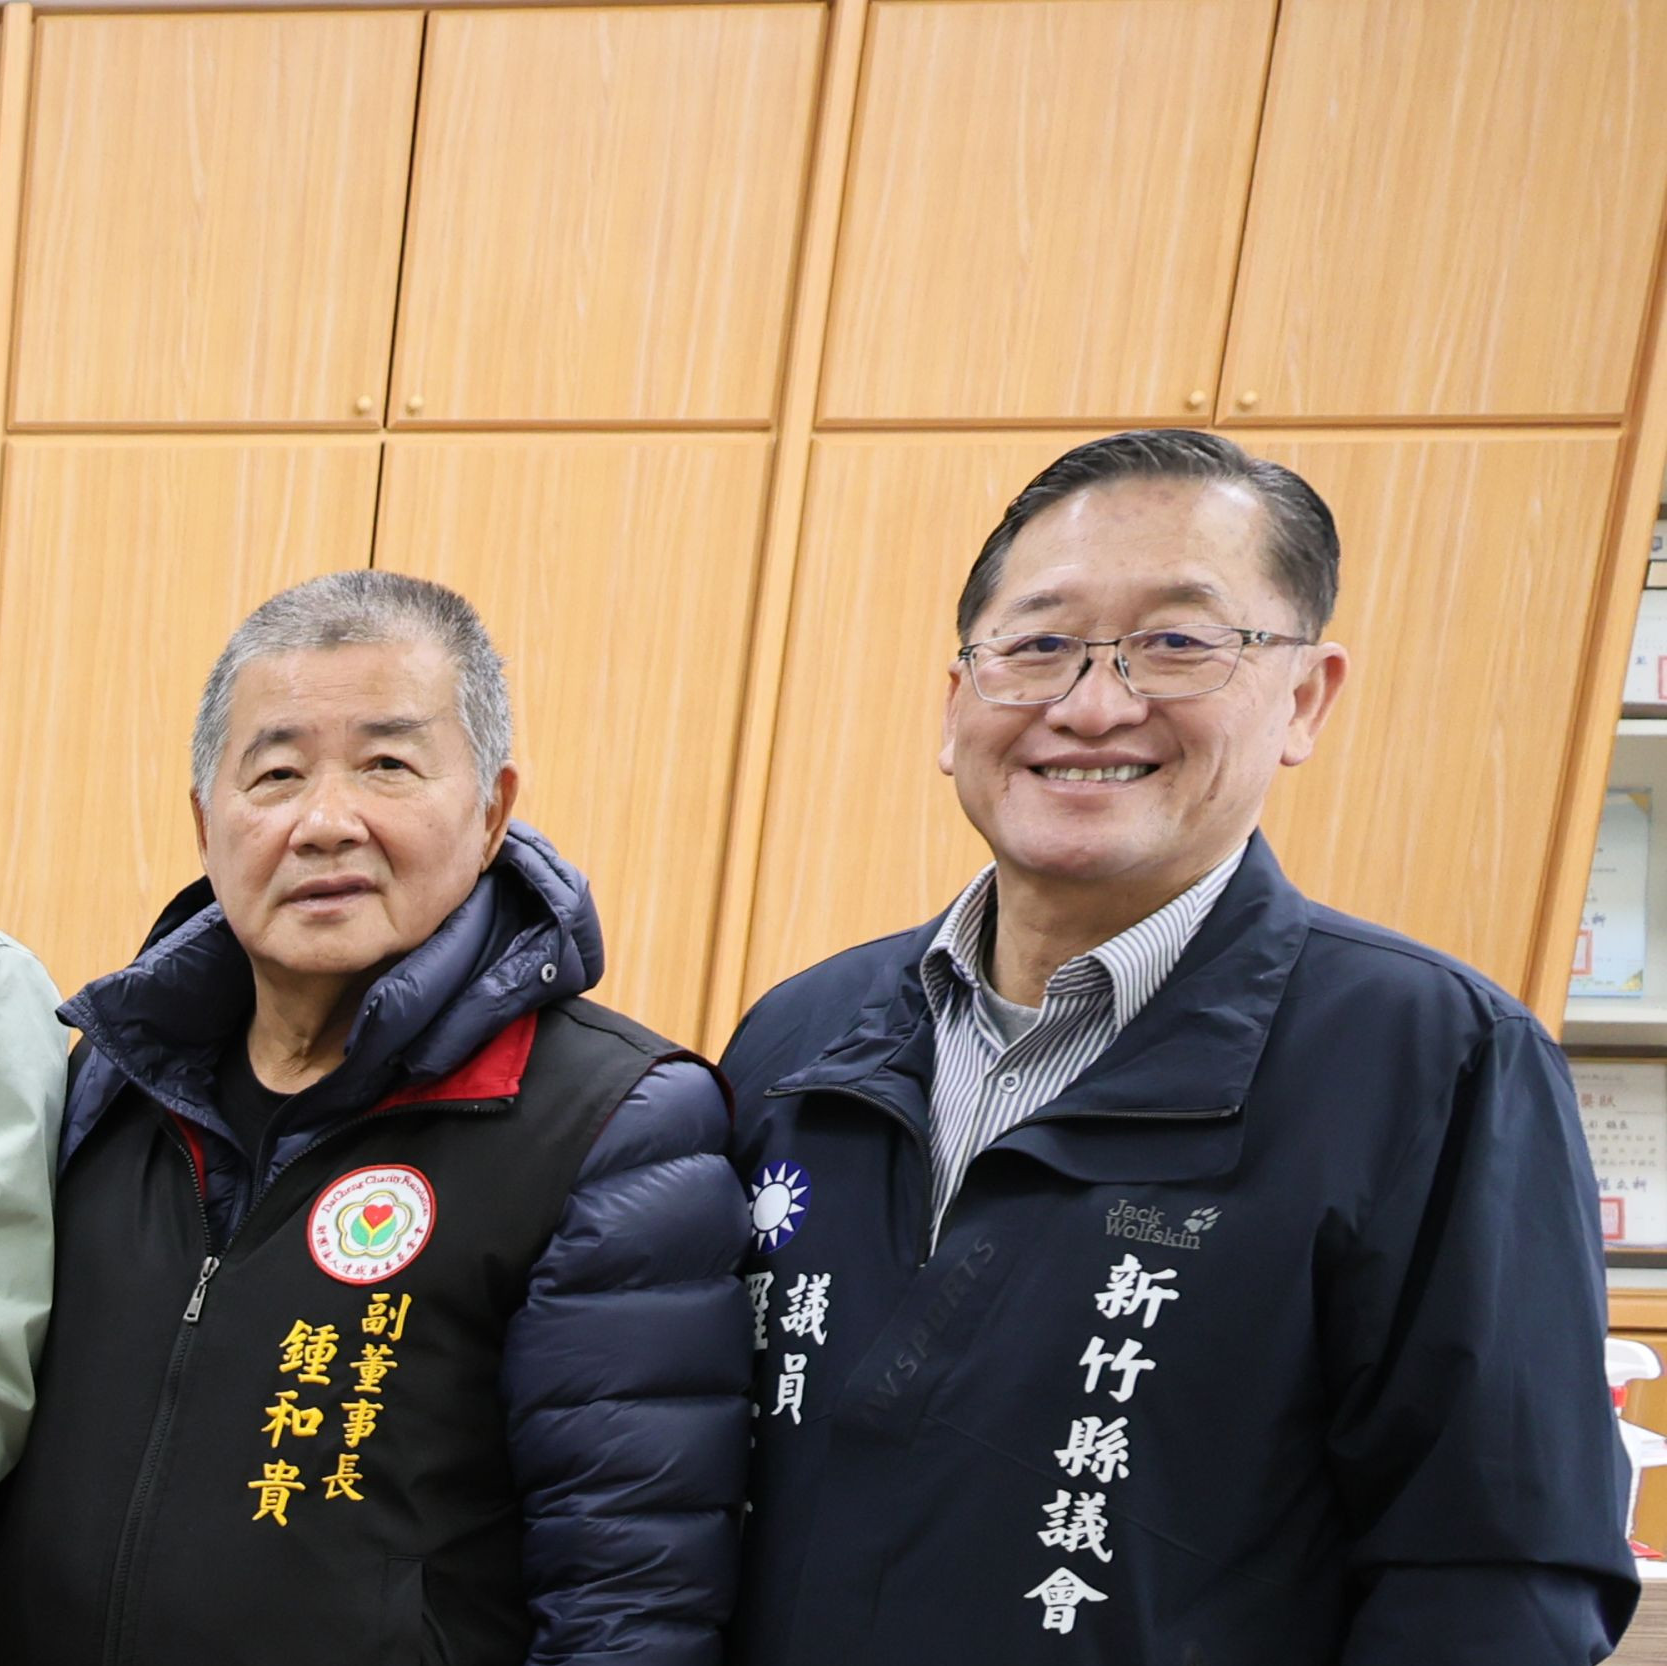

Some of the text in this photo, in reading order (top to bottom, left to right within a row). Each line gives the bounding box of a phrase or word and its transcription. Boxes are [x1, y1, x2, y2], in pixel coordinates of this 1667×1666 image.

[365, 1174, 402, 1185] Charity
[1105, 1215, 1201, 1250] Wolfskin
[1108, 1199, 1166, 1225] Jack
[246, 1318, 340, 1528] 鍾和貴
[321, 1292, 412, 1502] 副董事長
[779, 1272, 832, 1425] 議員
[1023, 1253, 1181, 1635] 新竹縣議會
